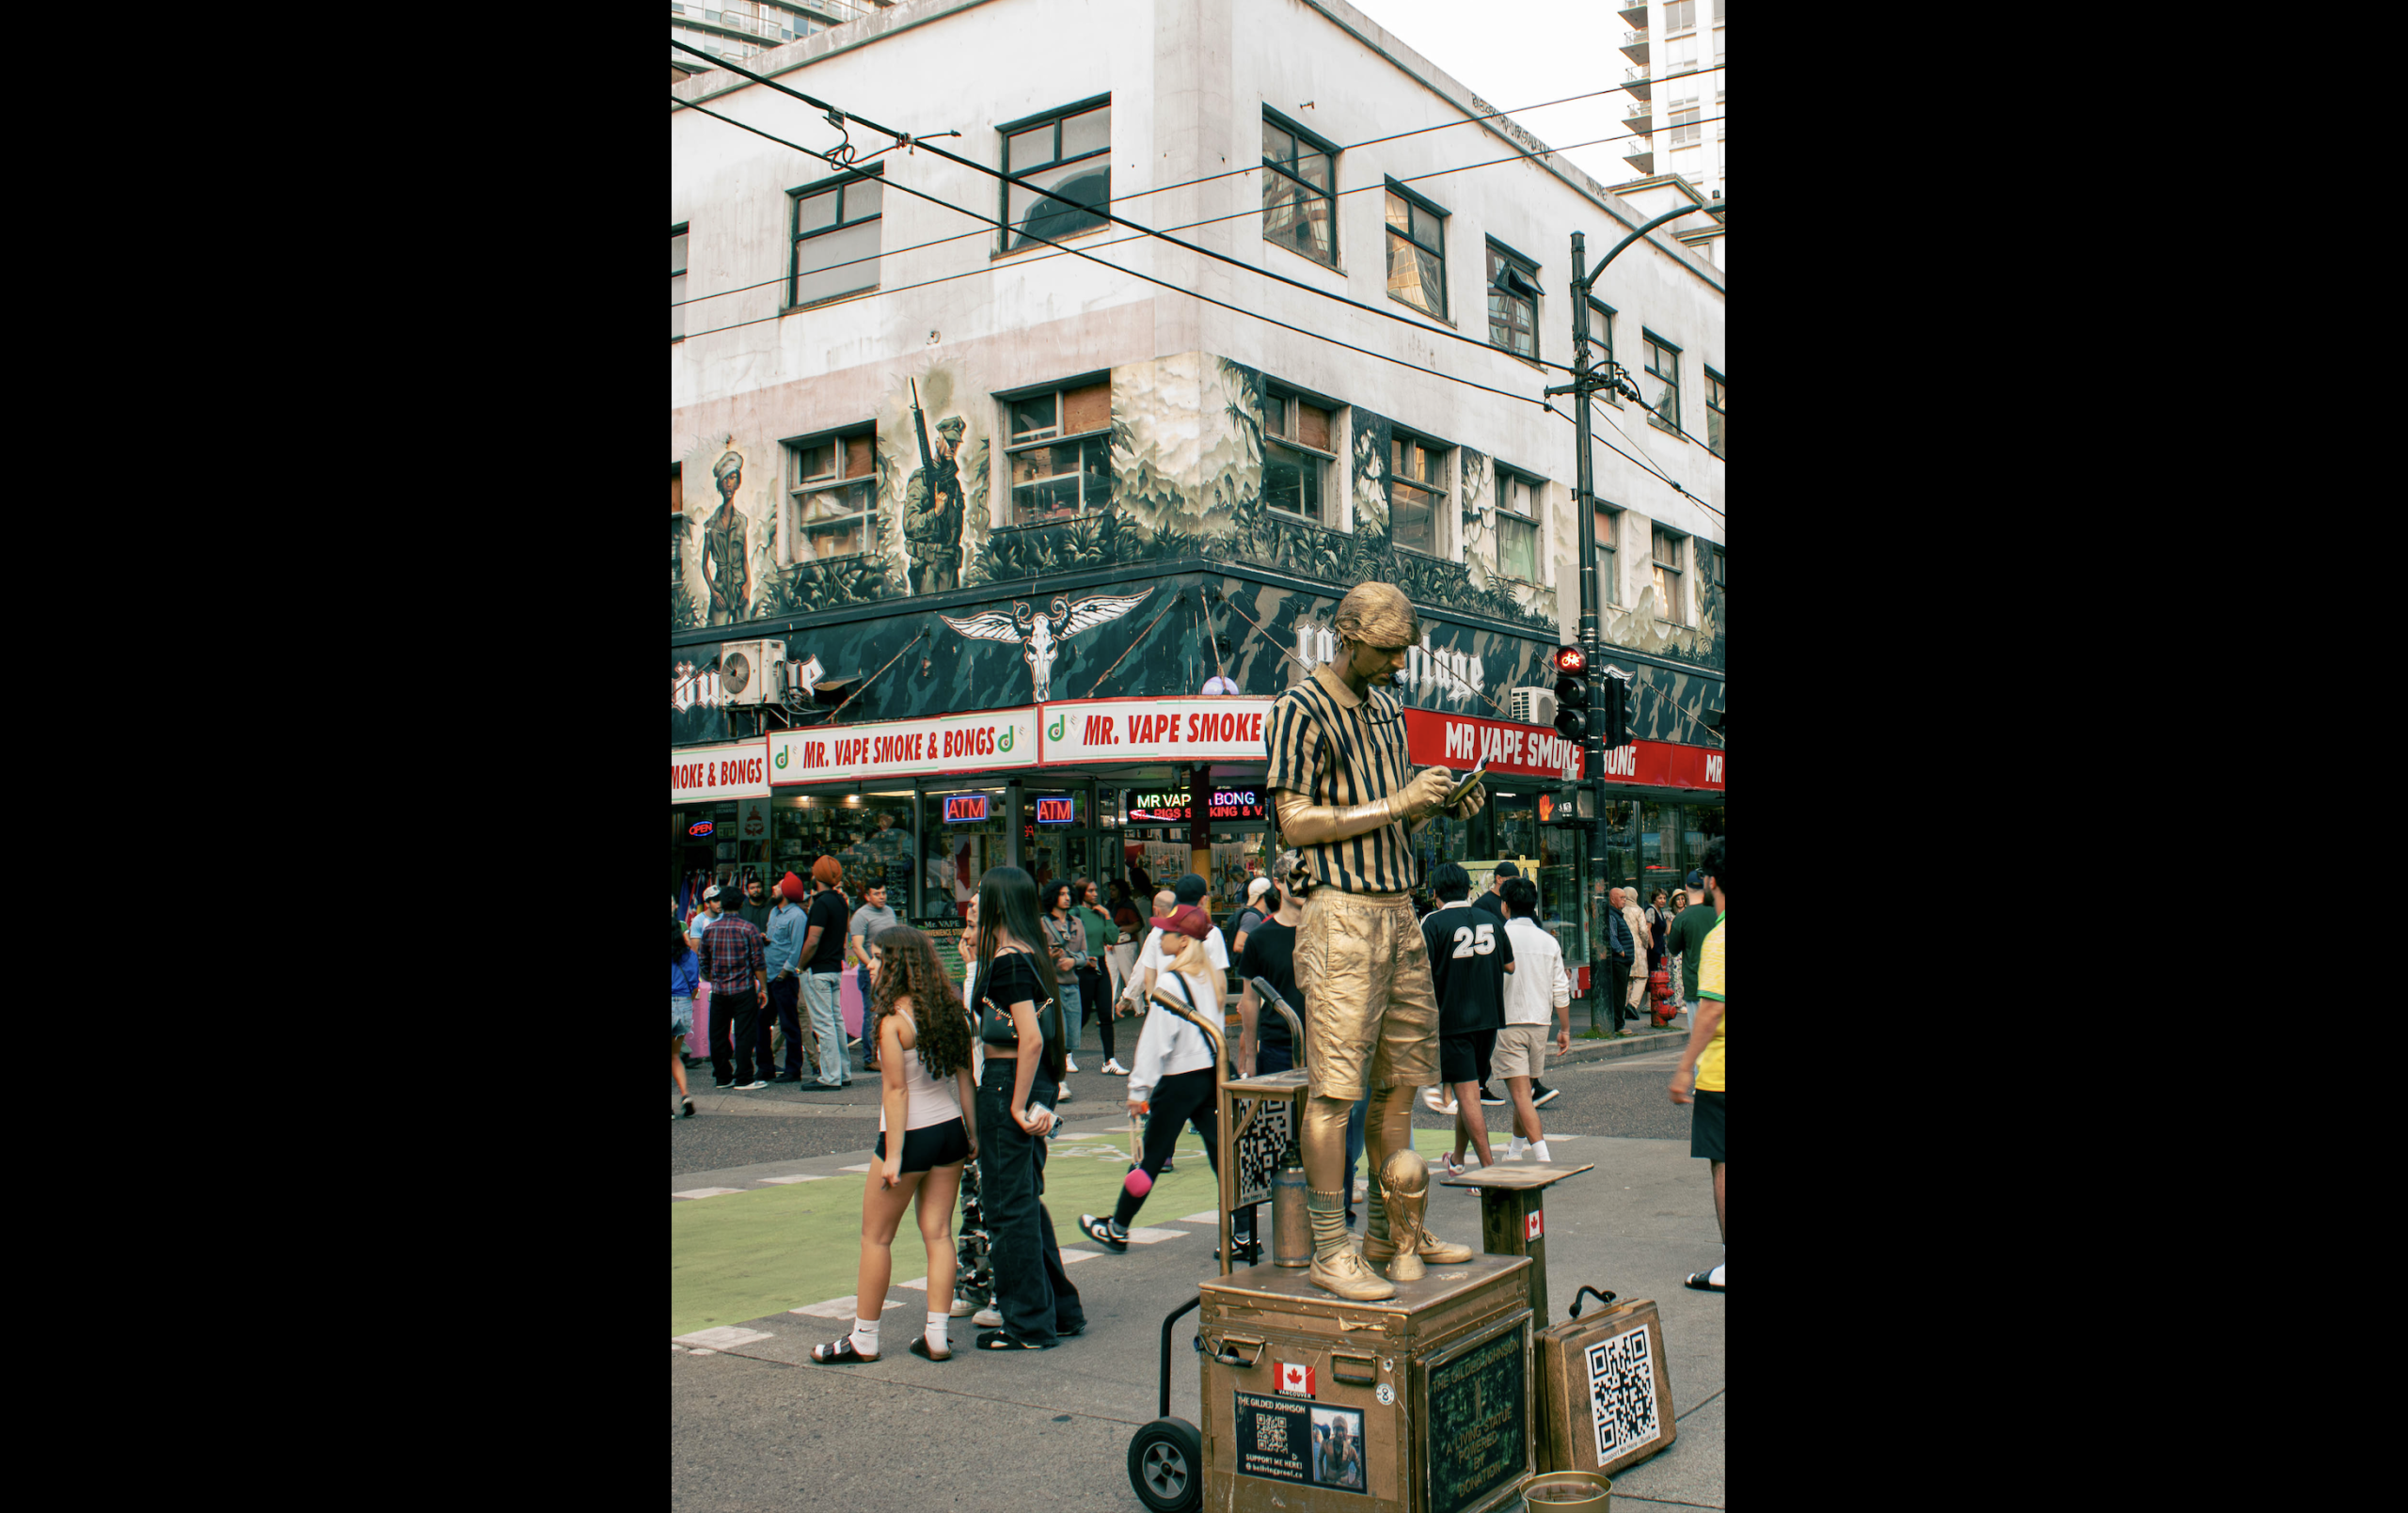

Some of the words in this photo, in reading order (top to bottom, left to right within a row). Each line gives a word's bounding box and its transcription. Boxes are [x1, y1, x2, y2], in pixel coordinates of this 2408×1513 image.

[1083, 715, 1119, 746] MR.
[1128, 714, 1180, 744] VAPE
[1187, 713, 1262, 743] SMOKE
[803, 741, 829, 768] MR.
[835, 738, 869, 766] VAPE
[873, 733, 923, 764] SMOKE
[927, 732, 938, 759] &
[943, 726, 995, 758] BONGS
[1446, 721, 1475, 760] MR
[1480, 726, 1524, 764] VAPE
[1527, 733, 1580, 770] SMOKE
[707, 762, 716, 787] &
[721, 757, 762, 786] BONGS
[1705, 754, 1722, 783] MR
[947, 796, 985, 819] ATM
[1038, 800, 1070, 820] ATM
[1137, 795, 1161, 808] MR
[1162, 794, 1192, 807] VAP
[1214, 792, 1255, 805] BONG
[1154, 808, 1182, 819] RIGS
[1243, 806, 1250, 816] &
[689, 823, 713, 836] OPEN
[938, 920, 960, 928] VAPE
[1452, 923, 1497, 959] 25
[1432, 1375, 1450, 1395] THE
[1450, 1359, 1482, 1384] GILDED
[1483, 1338, 1520, 1367] JOHNSON
[1237, 1395, 1250, 1407] THE
[1250, 1397, 1274, 1410] GILDED
[1275, 1401, 1307, 1414] JOHNSON
[1279, 1389, 1312, 1399] VANCOUVER
[1454, 1426, 1482, 1451] LIVING
[1483, 1406, 1513, 1432] STATUE
[1245, 1453, 1273, 1465] SUPPORT
[1274, 1458, 1283, 1467] ME
[1459, 1431, 1498, 1464] POWERED
[1473, 1454, 1486, 1470] BY
[1459, 1460, 1501, 1498] DONATION
